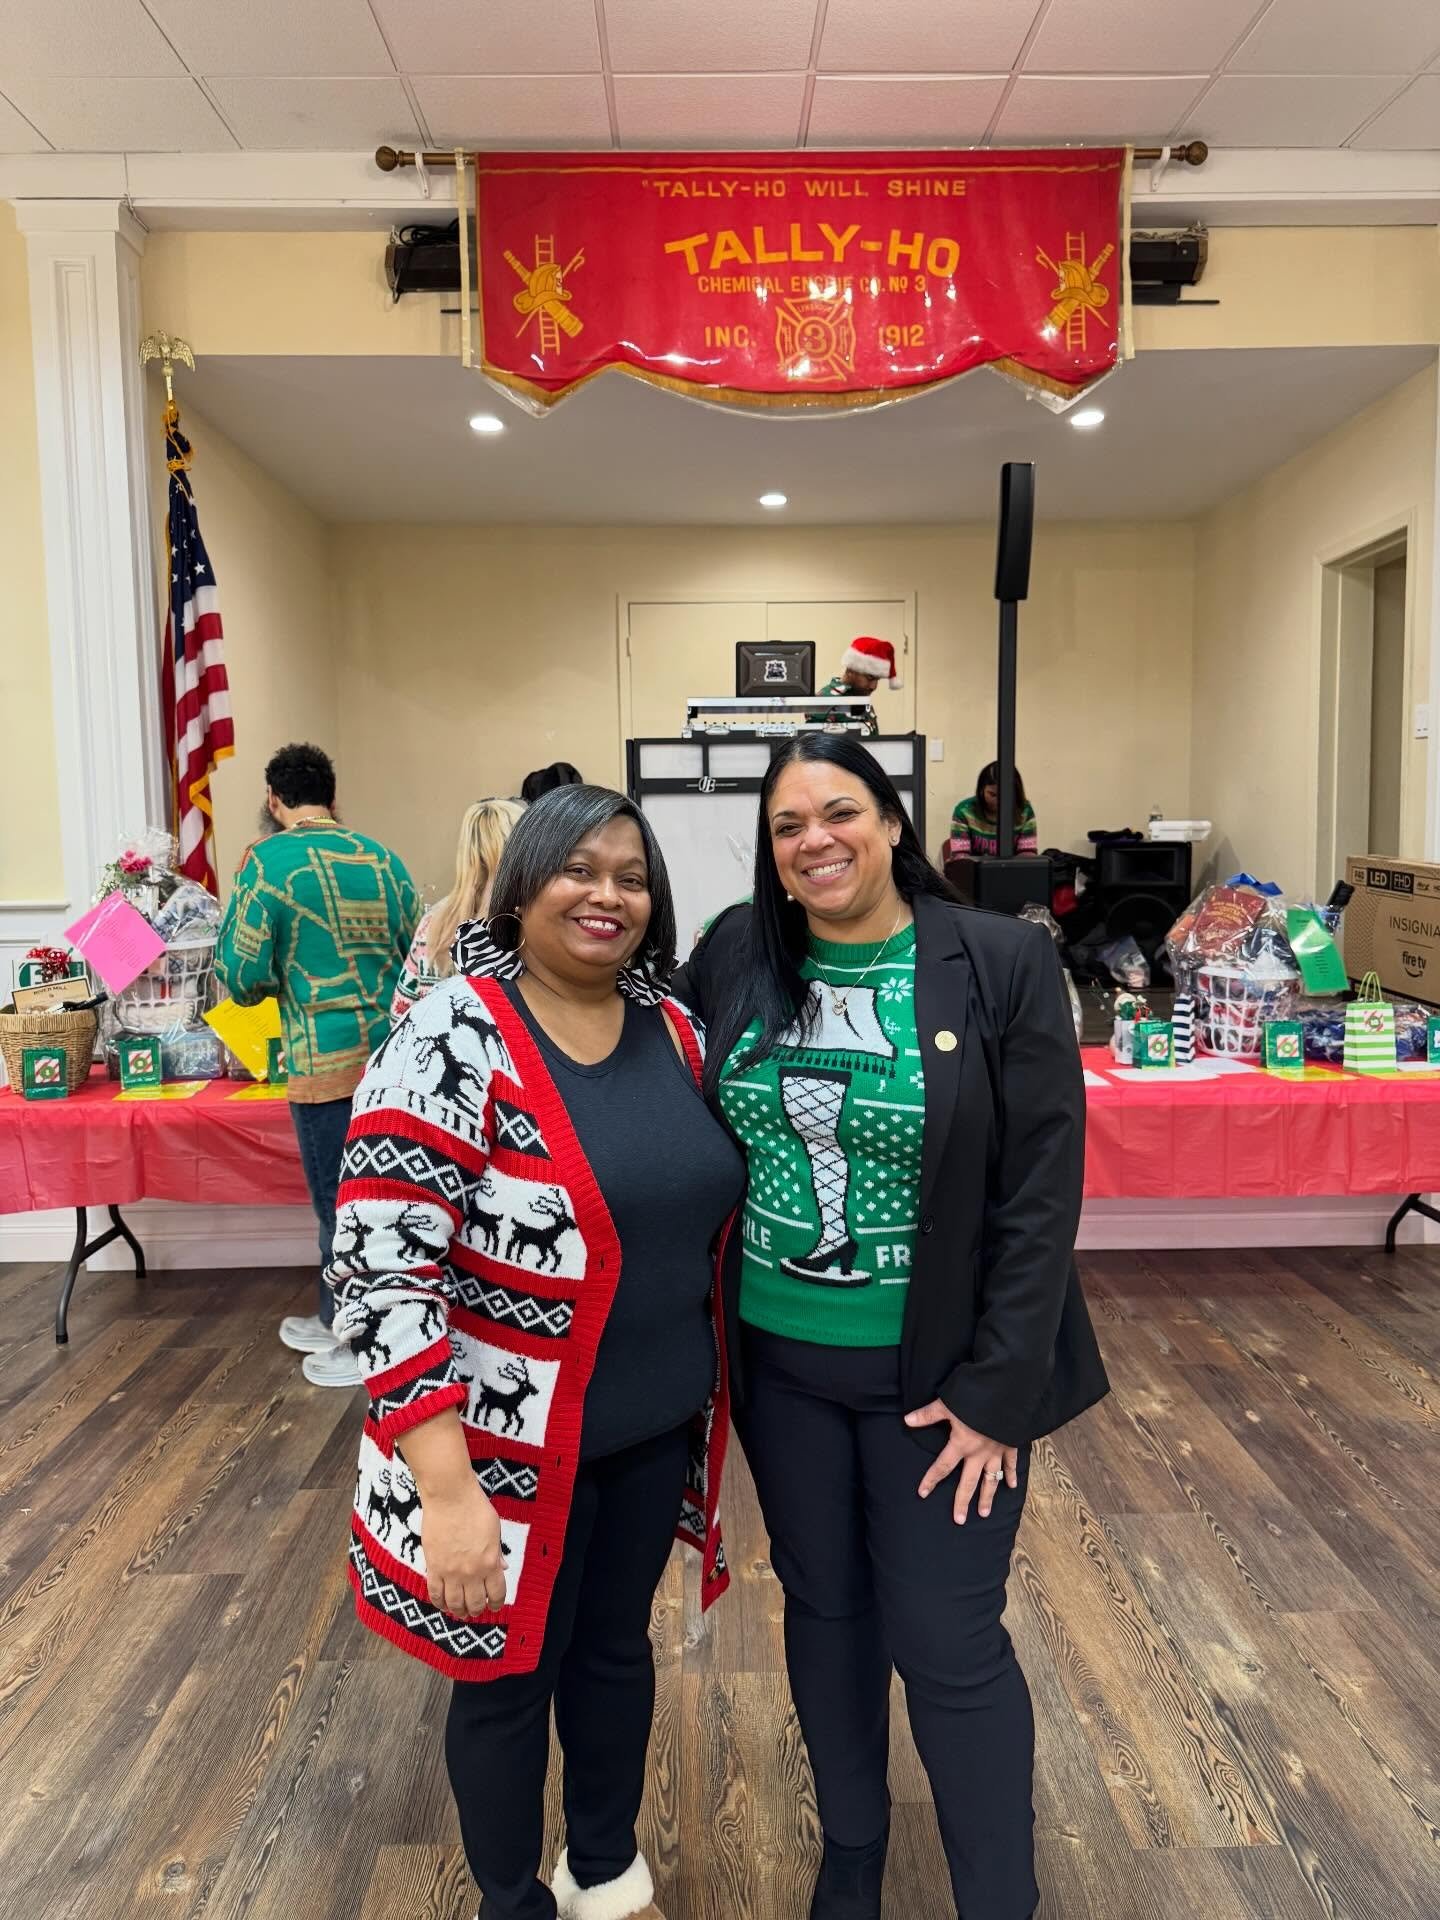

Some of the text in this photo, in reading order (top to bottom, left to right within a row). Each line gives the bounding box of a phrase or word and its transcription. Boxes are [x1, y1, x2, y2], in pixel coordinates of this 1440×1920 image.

[664, 223, 960, 278] TALLY-HO
[697, 275, 785, 294] CHEMICAL
[914, 274, 927, 292] 3
[704, 325, 758, 348] INC.
[804, 323, 828, 354] 3
[878, 324, 925, 349] 1912
[1369, 870, 1388, 887] LED
[1393, 873, 1411, 889] FHD
[1389, 915, 1440, 938] INSIGNIA
[1402, 950, 1427, 970] fire tv
[742, 1213, 772, 1251] ILE
